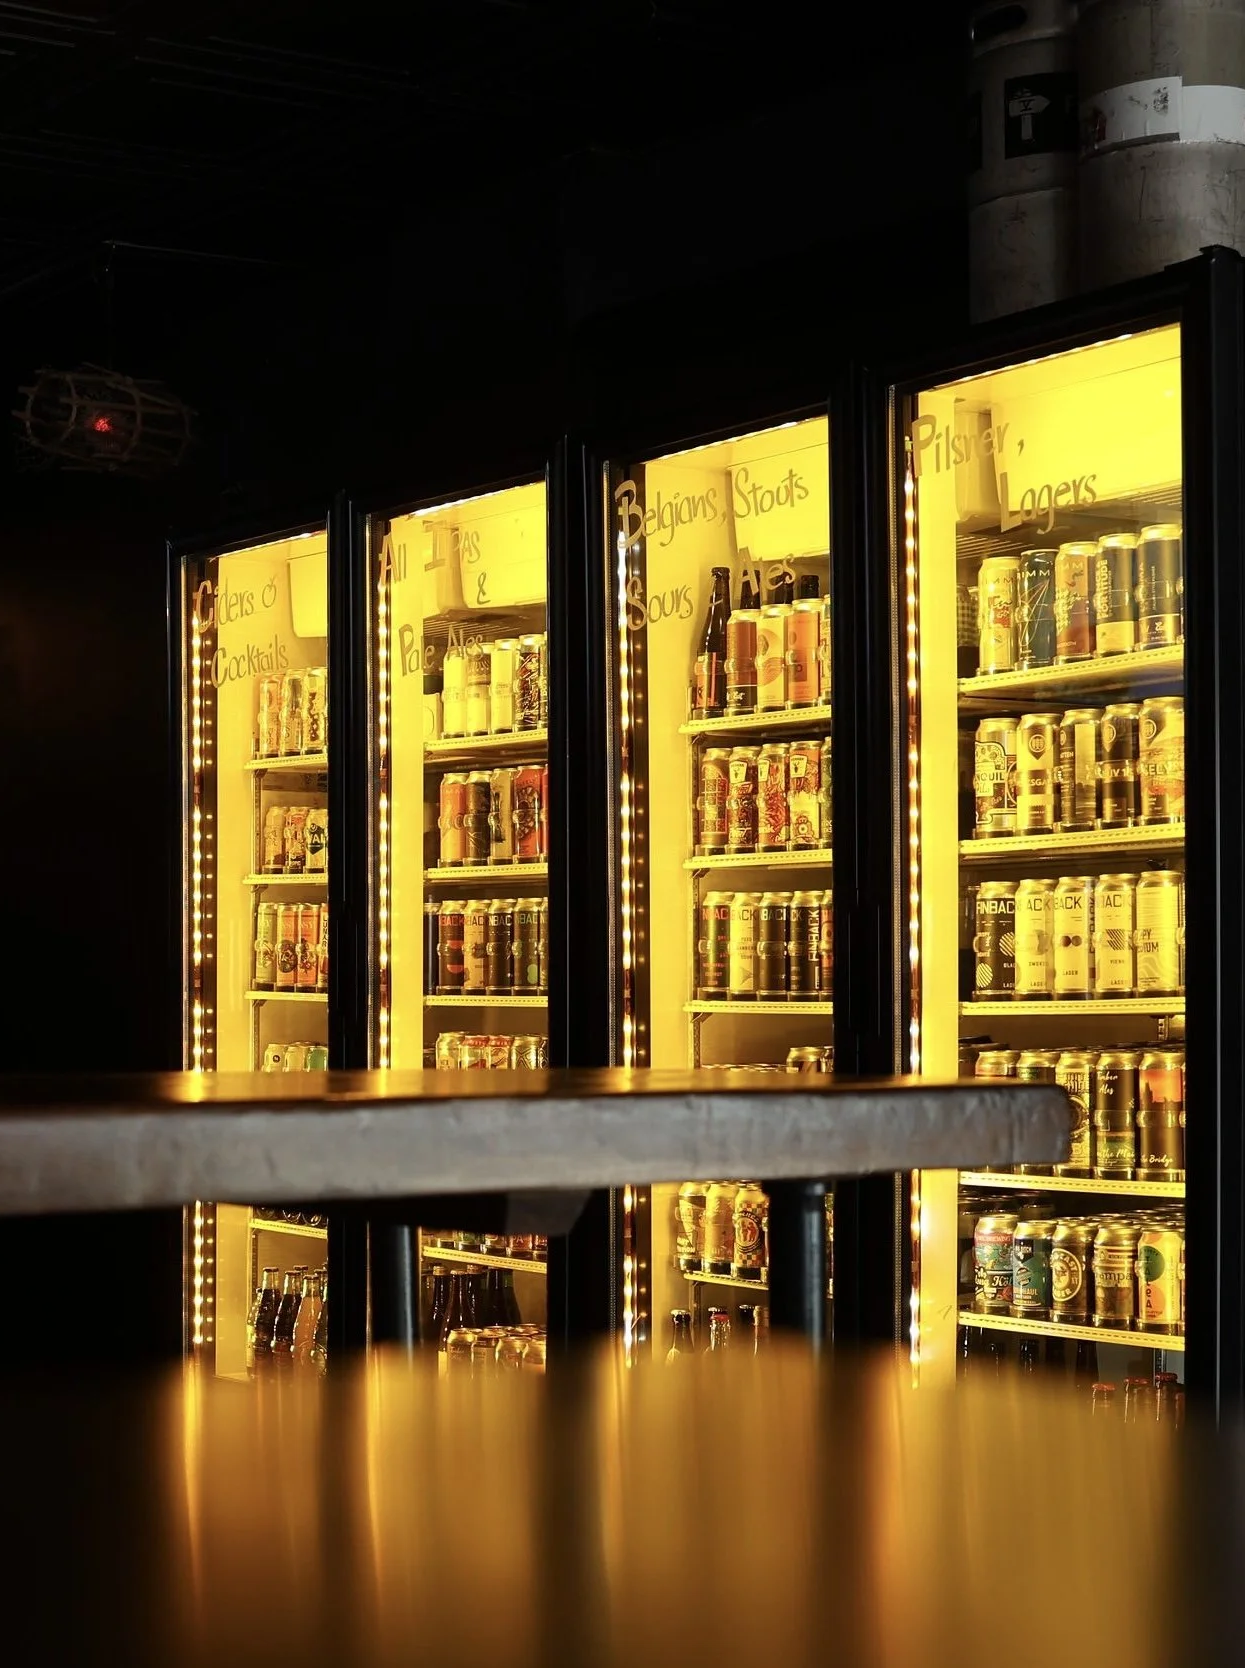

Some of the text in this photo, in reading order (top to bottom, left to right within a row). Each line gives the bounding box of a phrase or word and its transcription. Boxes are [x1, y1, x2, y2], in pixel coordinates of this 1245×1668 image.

[614, 467, 809, 548] Belgians, Stouts
[1000, 472, 1097, 534] Lagers
[380, 532, 407, 585] All
[196, 576, 254, 633] Ciders
[627, 546, 796, 631] Sours Ales
[211, 634, 289, 689] Cocktails
[399, 623, 485, 676] Pale Ales
[808, 909, 820, 962] FINBACK
